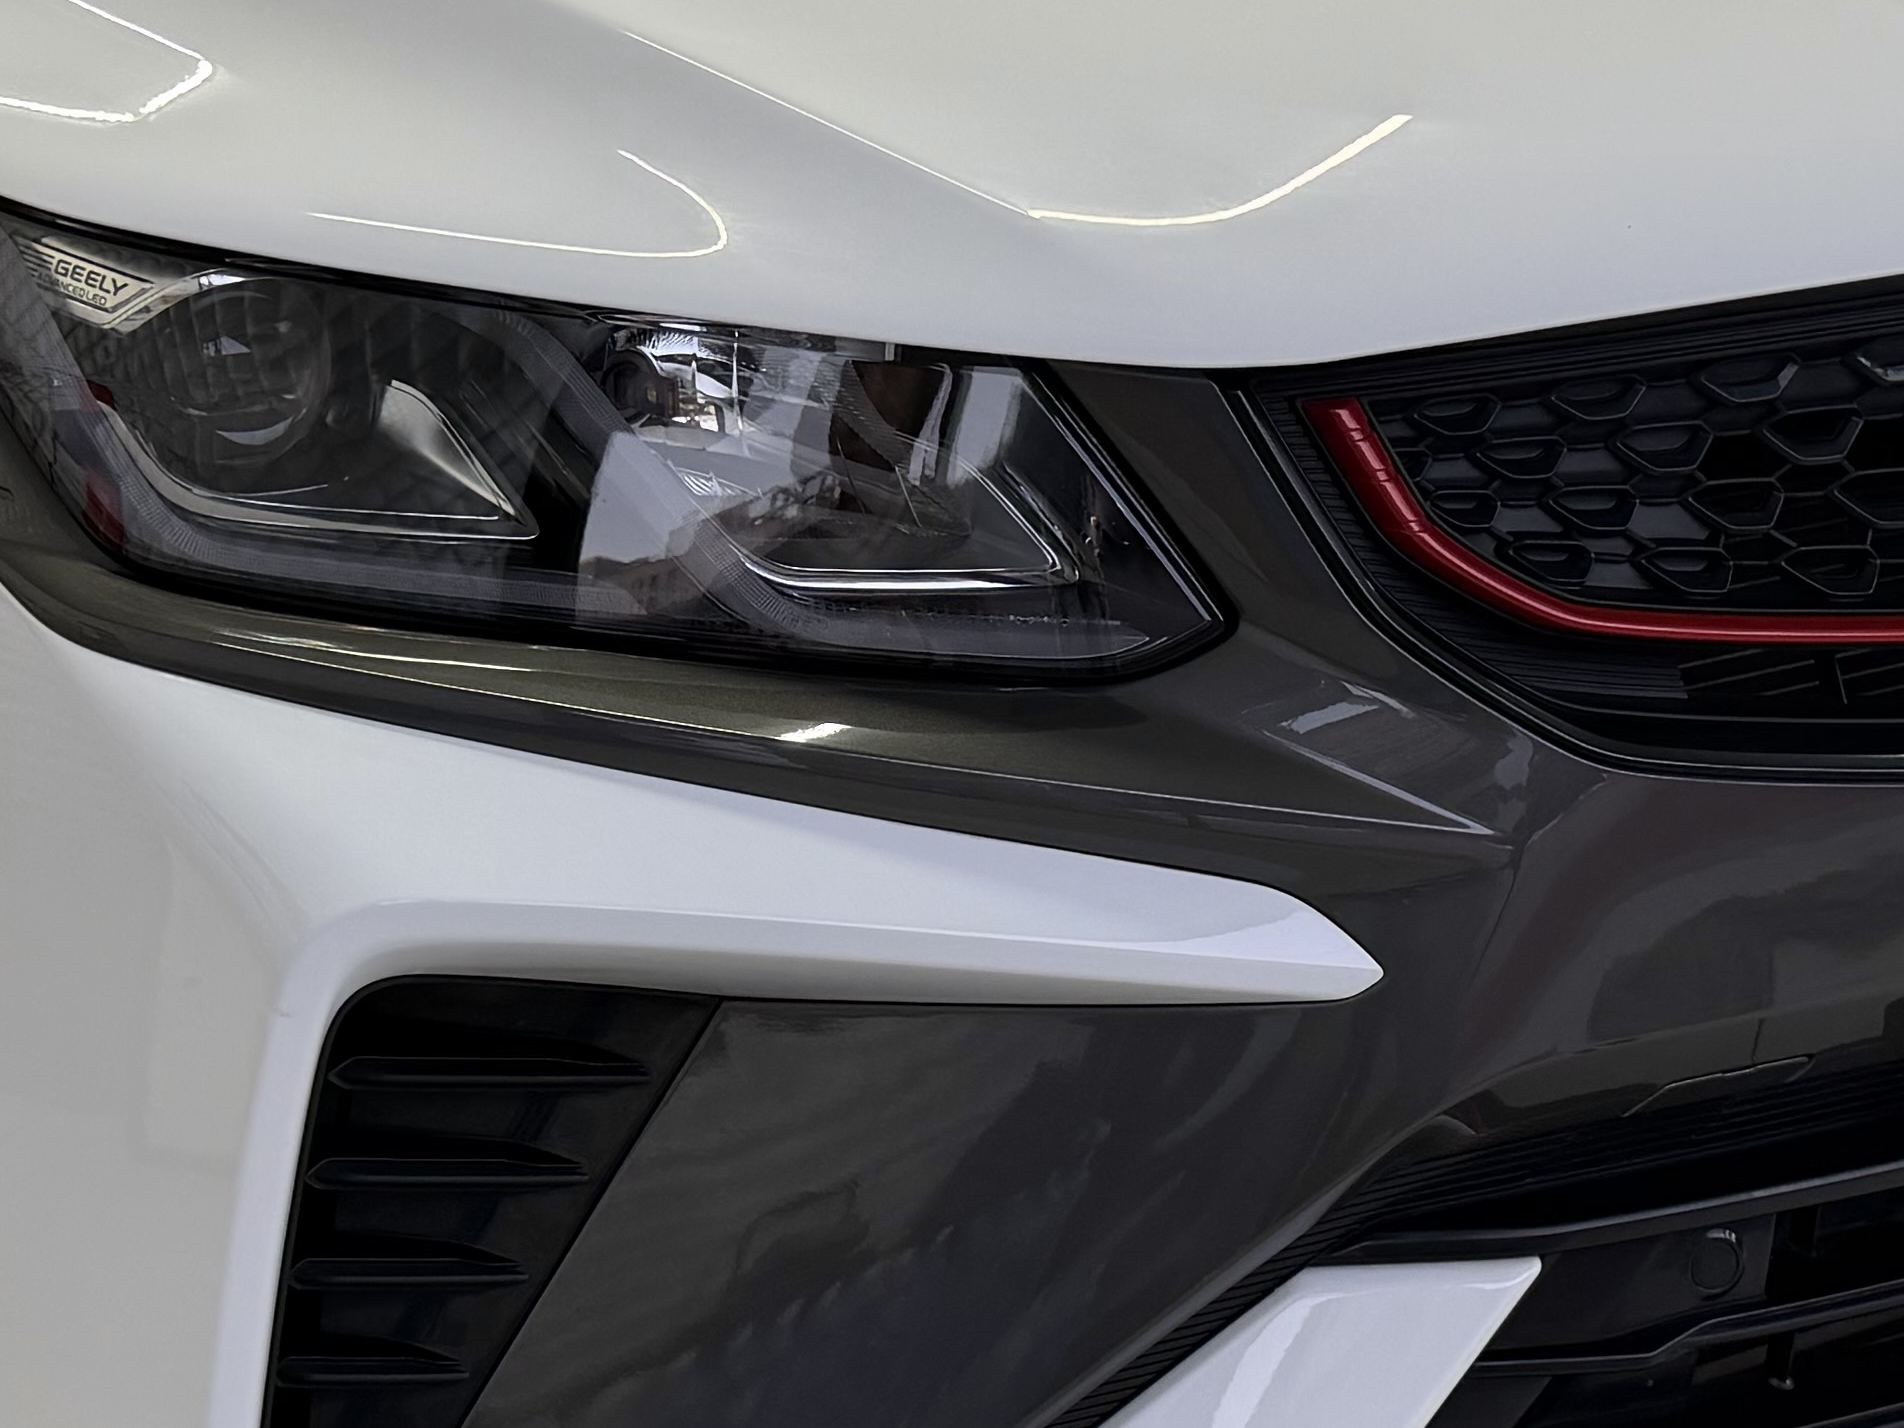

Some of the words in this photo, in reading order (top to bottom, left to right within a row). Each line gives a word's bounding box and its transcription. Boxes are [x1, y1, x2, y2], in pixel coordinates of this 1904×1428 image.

[38, 272, 85, 298] ADVANCED
[86, 291, 108, 306] LED
[54, 259, 129, 296] GEELY
